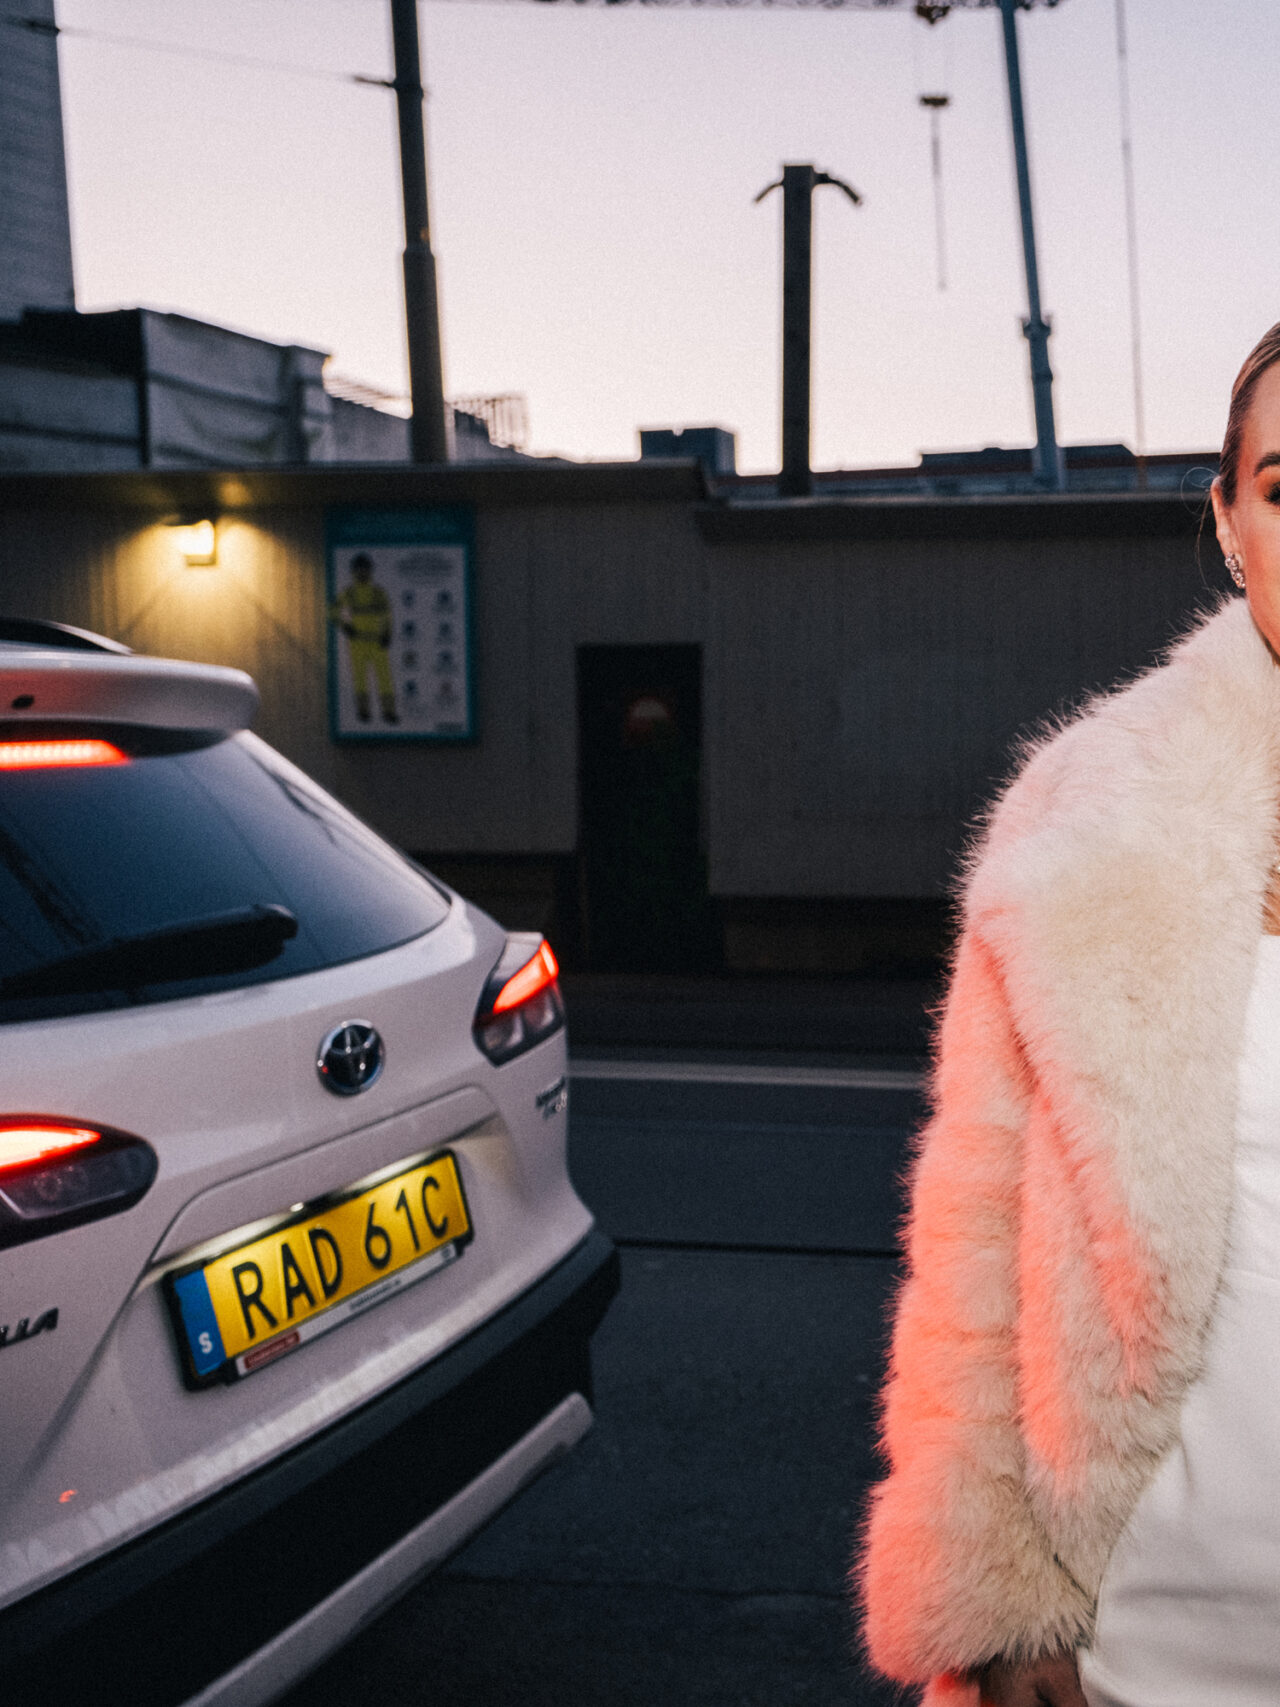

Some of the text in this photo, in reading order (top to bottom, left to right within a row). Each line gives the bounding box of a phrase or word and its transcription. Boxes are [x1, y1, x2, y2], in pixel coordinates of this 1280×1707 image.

[231, 1175, 449, 1340] RAD 61C
[198, 1331, 213, 1354] S
